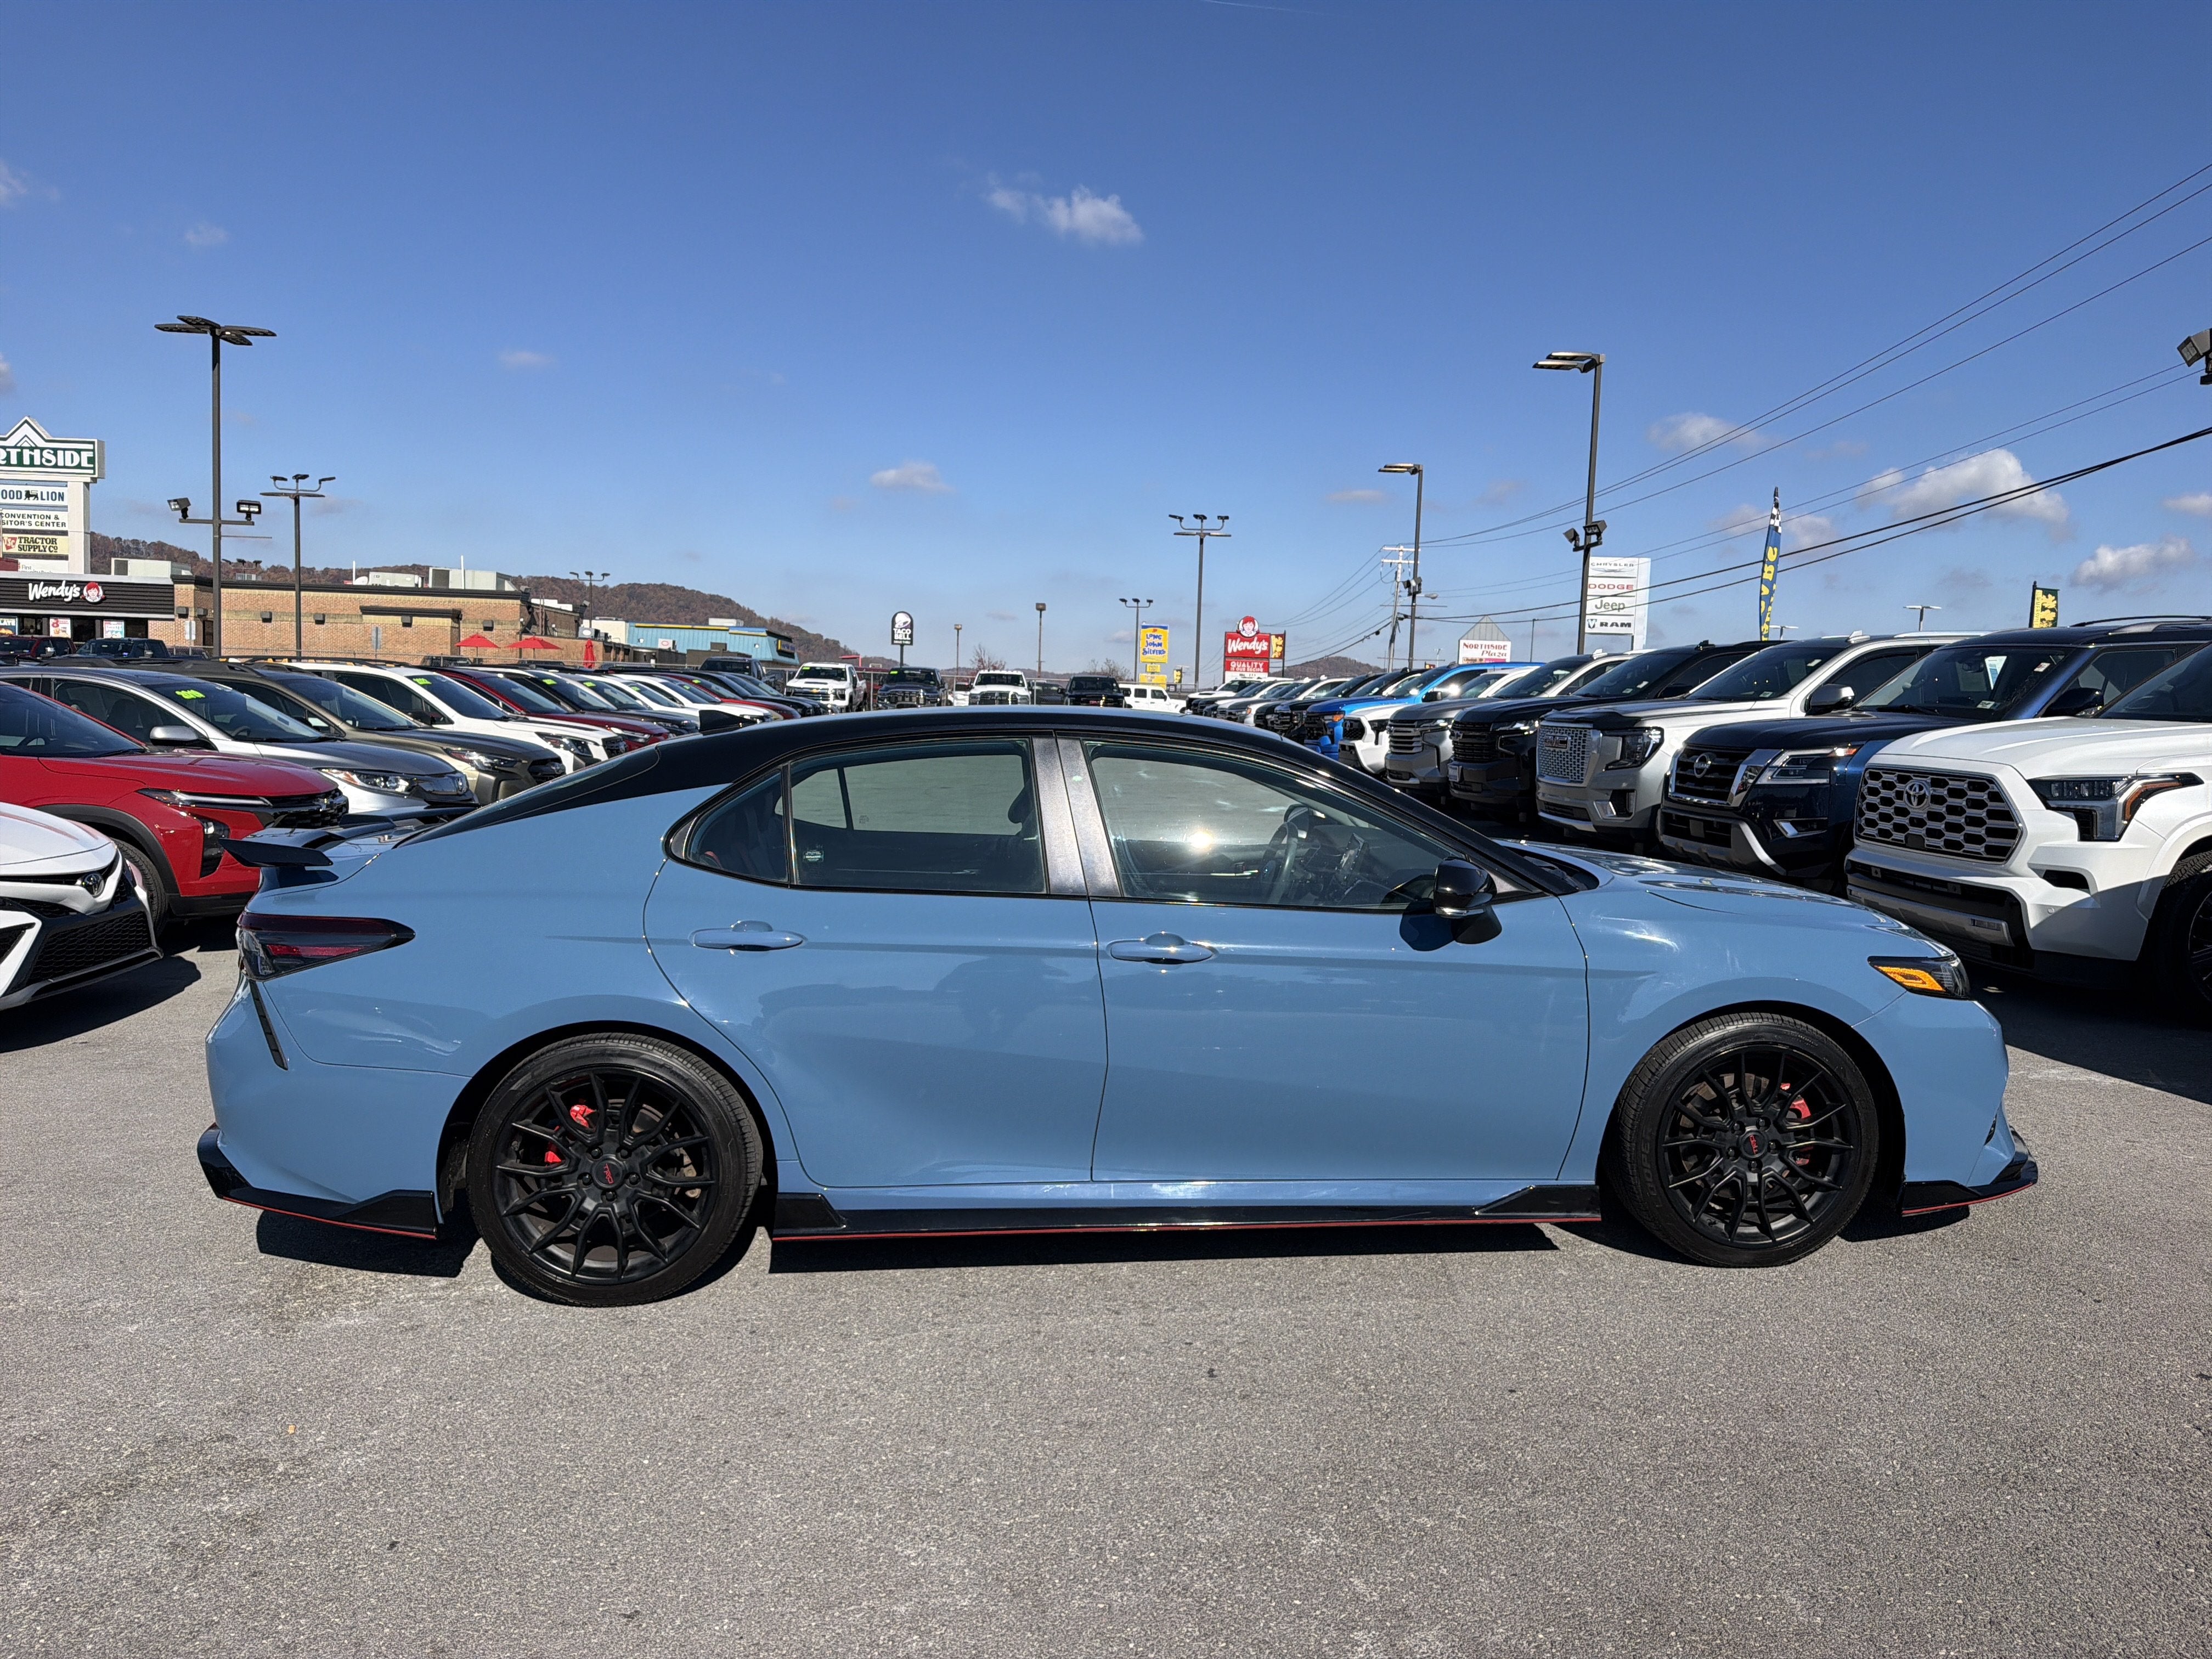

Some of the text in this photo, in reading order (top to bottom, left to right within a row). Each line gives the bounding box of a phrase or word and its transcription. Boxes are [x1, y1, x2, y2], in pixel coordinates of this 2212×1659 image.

[1, 489, 64, 501] OOD LION
[18, 537, 58, 545] TRACTOR
[29, 580, 80, 602] Wendy's
[1594, 600, 1626, 612] Jeep
[1227, 636, 1269, 654] Wendy's
[603, 1163, 614, 1184] TRD
